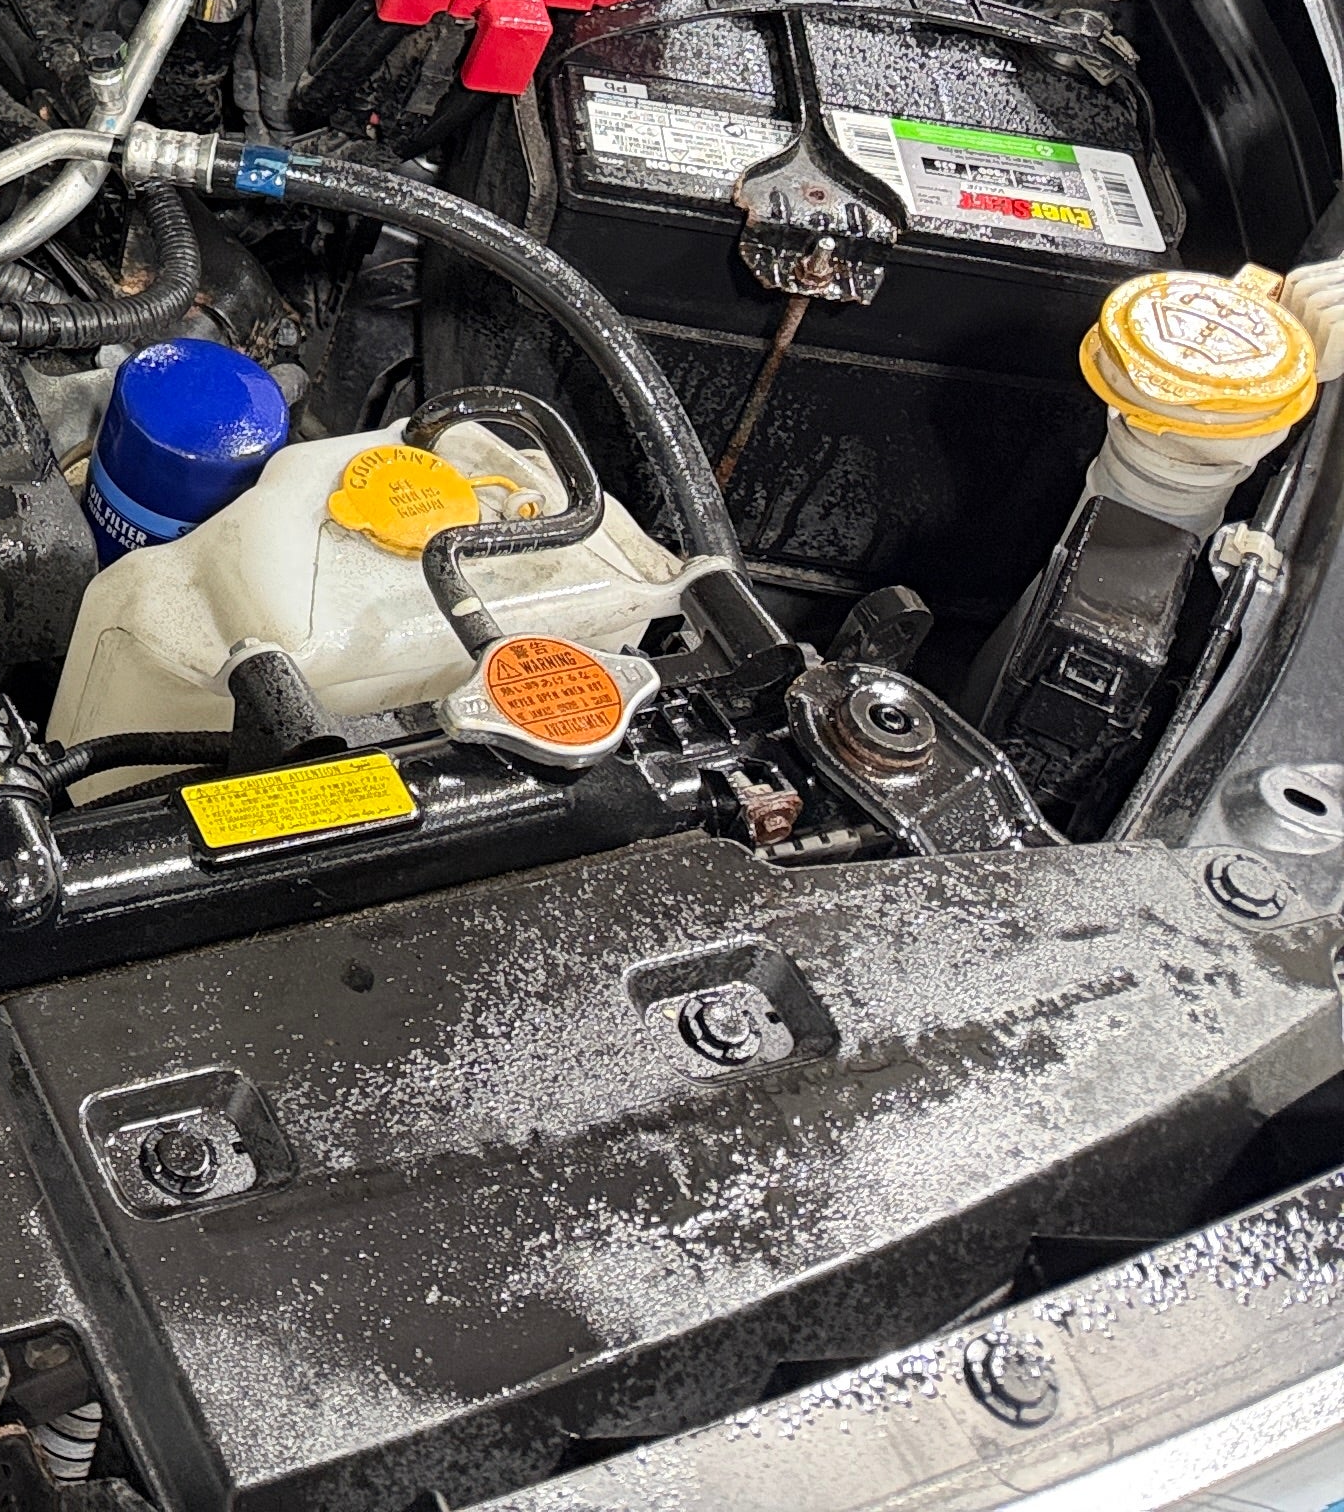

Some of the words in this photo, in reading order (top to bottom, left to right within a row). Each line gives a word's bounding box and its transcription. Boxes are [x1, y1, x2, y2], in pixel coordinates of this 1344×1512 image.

[604, 82, 628, 93] Pb
[959, 190, 1096, 230] EverStart
[350, 448, 442, 489] COOLANT
[90, 484, 102, 511] OIL
[105, 507, 147, 545] FILTER
[106, 525, 116, 538] DE
[518, 651, 578, 676] WARNING
[506, 694, 535, 710] NEVER
[537, 690, 560, 706] OPEN
[562, 685, 586, 699] WHEN
[543, 710, 611, 738] AVERTISSEMENT
[238, 775, 282, 789] CAUTION
[288, 765, 342, 782] ATTENTION
